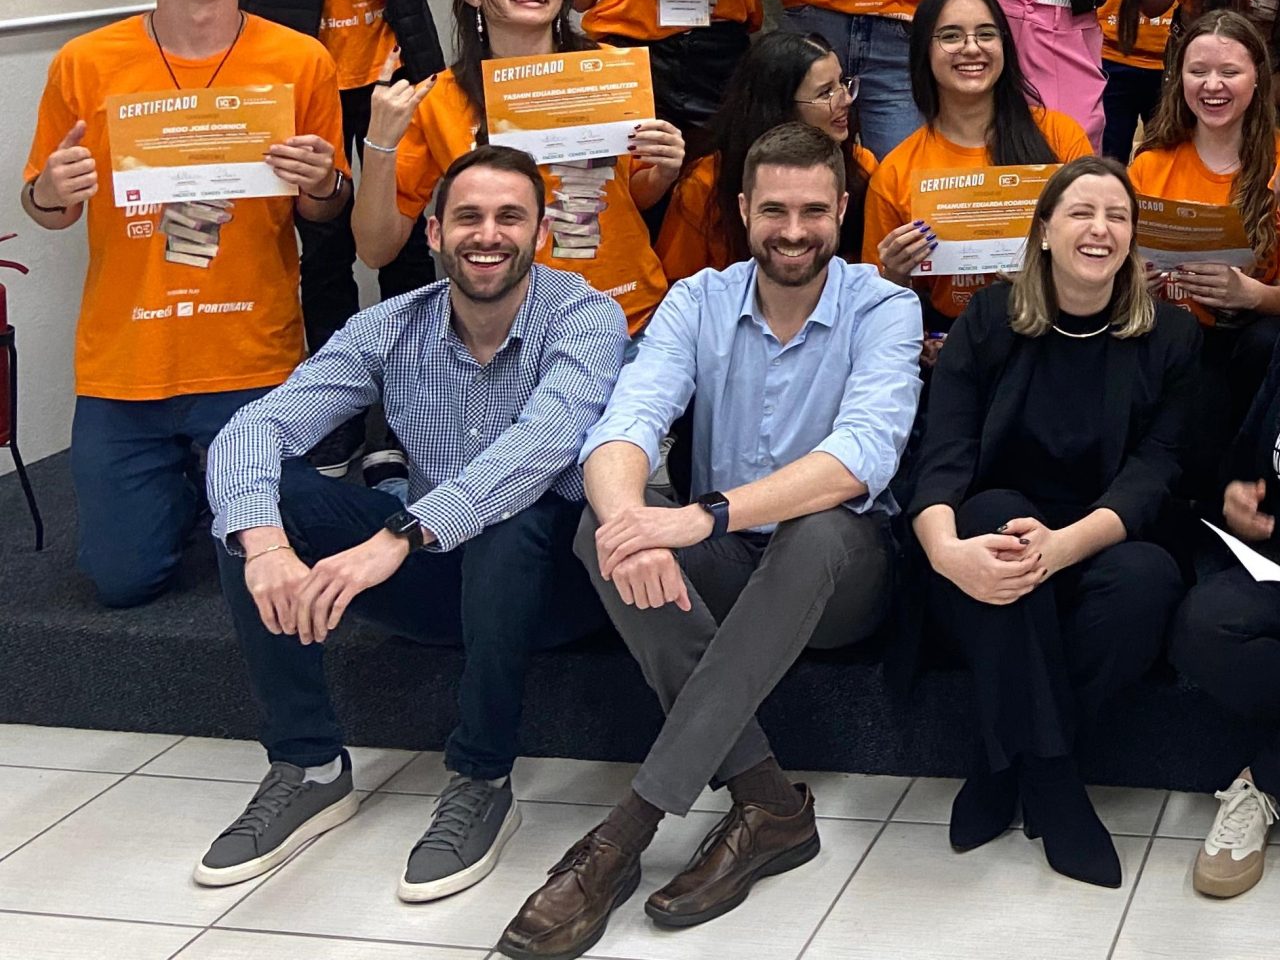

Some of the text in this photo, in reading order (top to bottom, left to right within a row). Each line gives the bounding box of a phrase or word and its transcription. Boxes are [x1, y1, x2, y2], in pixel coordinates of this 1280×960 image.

[493, 59, 565, 83] CERTIFICADO
[119, 95, 198, 119] CERTIFICADO
[920, 173, 985, 193] CERTIFICADO
